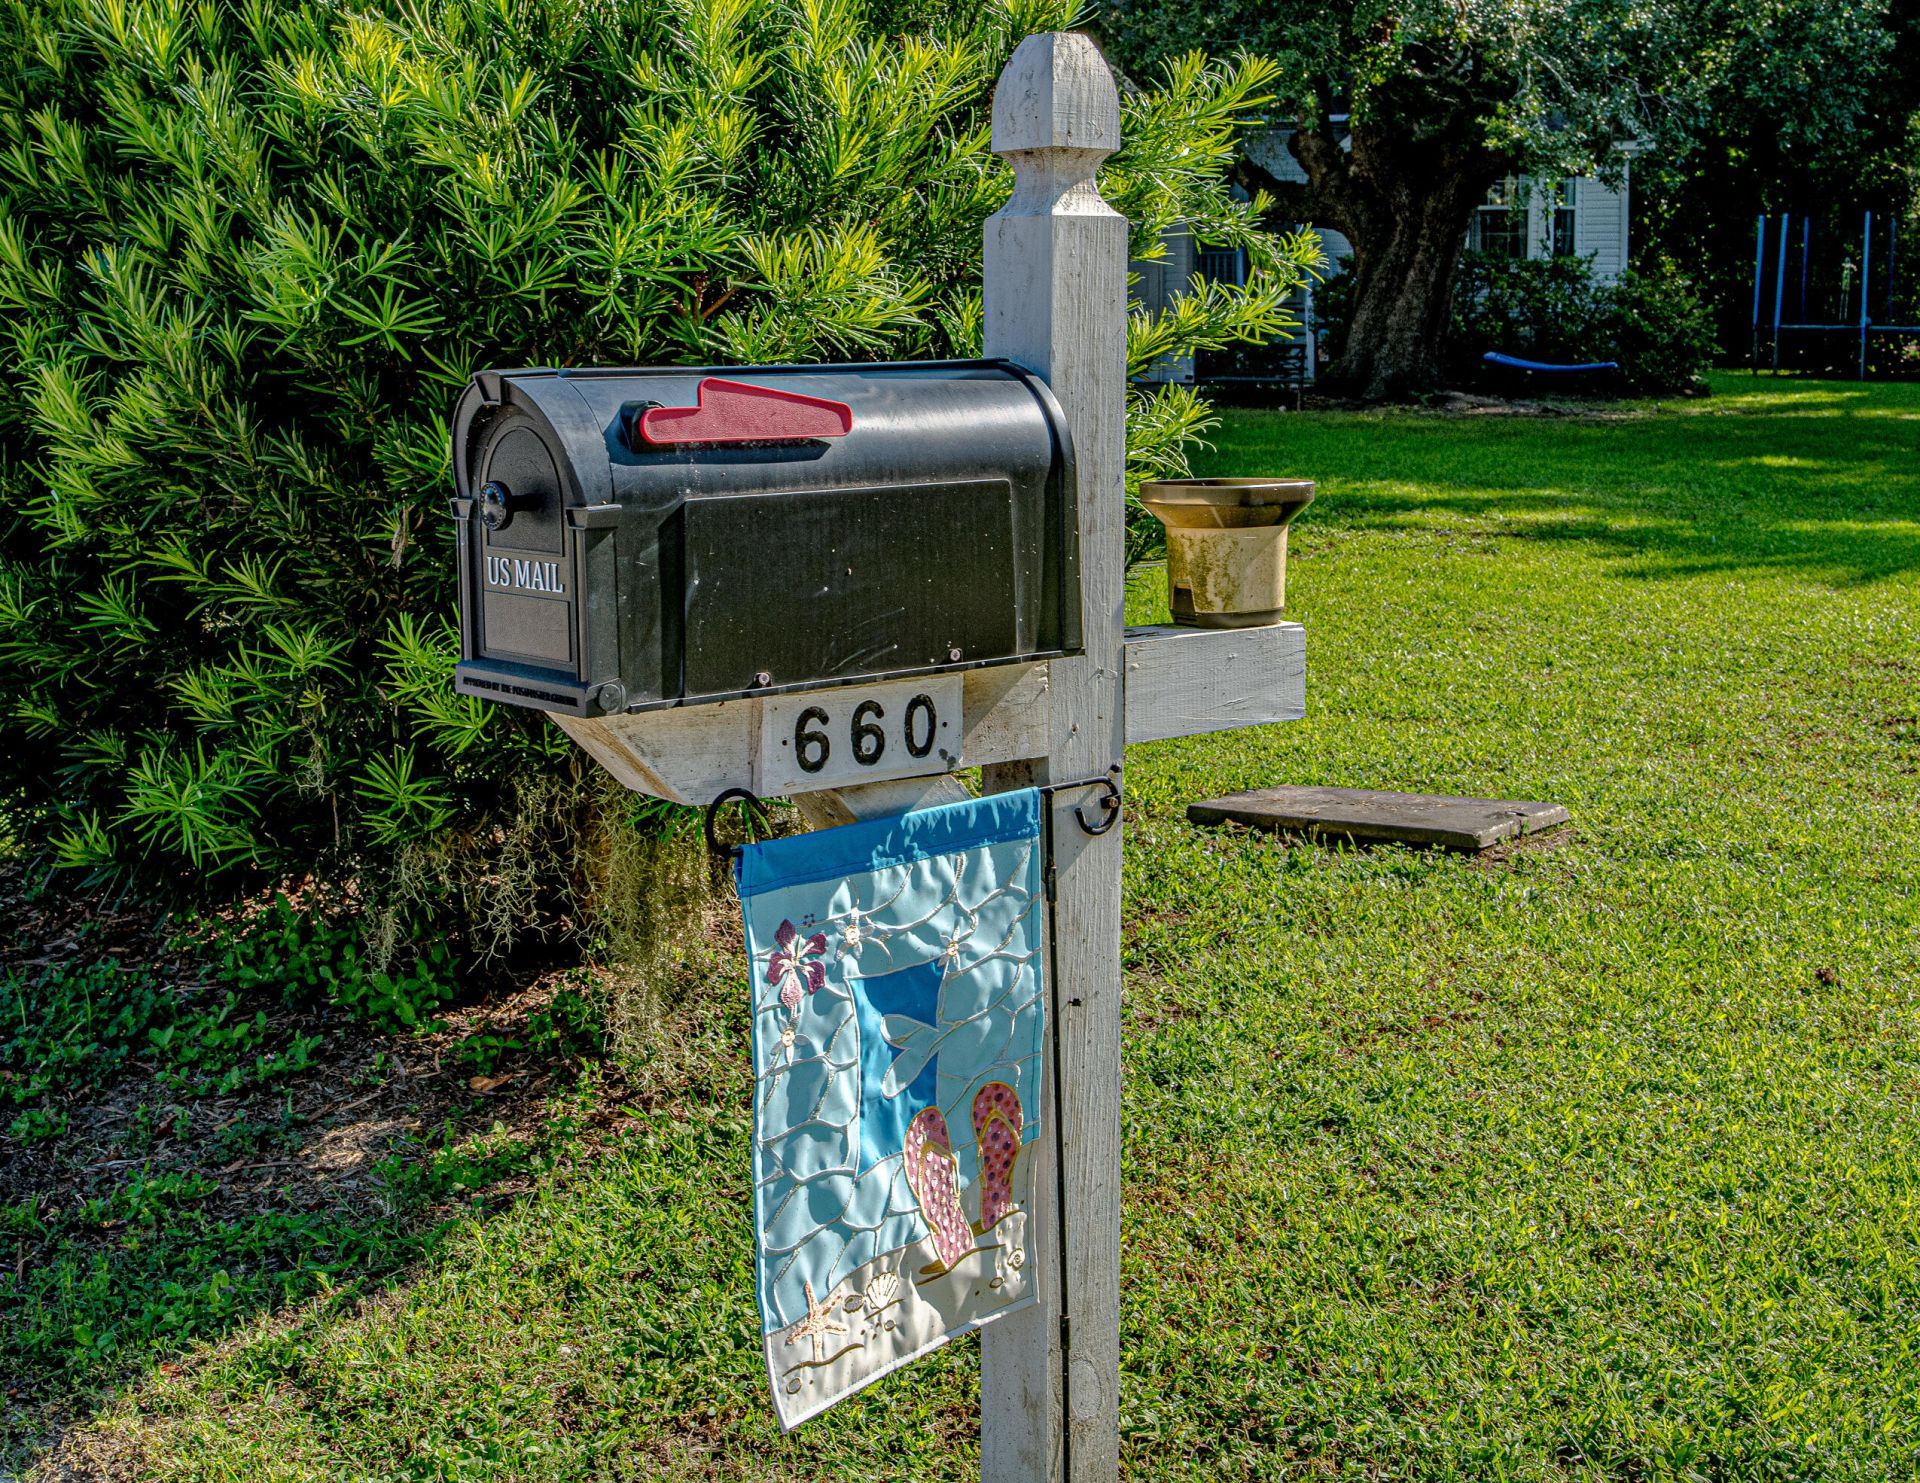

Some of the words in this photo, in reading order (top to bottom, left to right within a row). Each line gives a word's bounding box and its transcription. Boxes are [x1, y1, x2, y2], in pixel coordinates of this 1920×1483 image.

[487, 556, 511, 587] US
[514, 559, 564, 593] MAIL
[795, 693, 936, 774] 660
